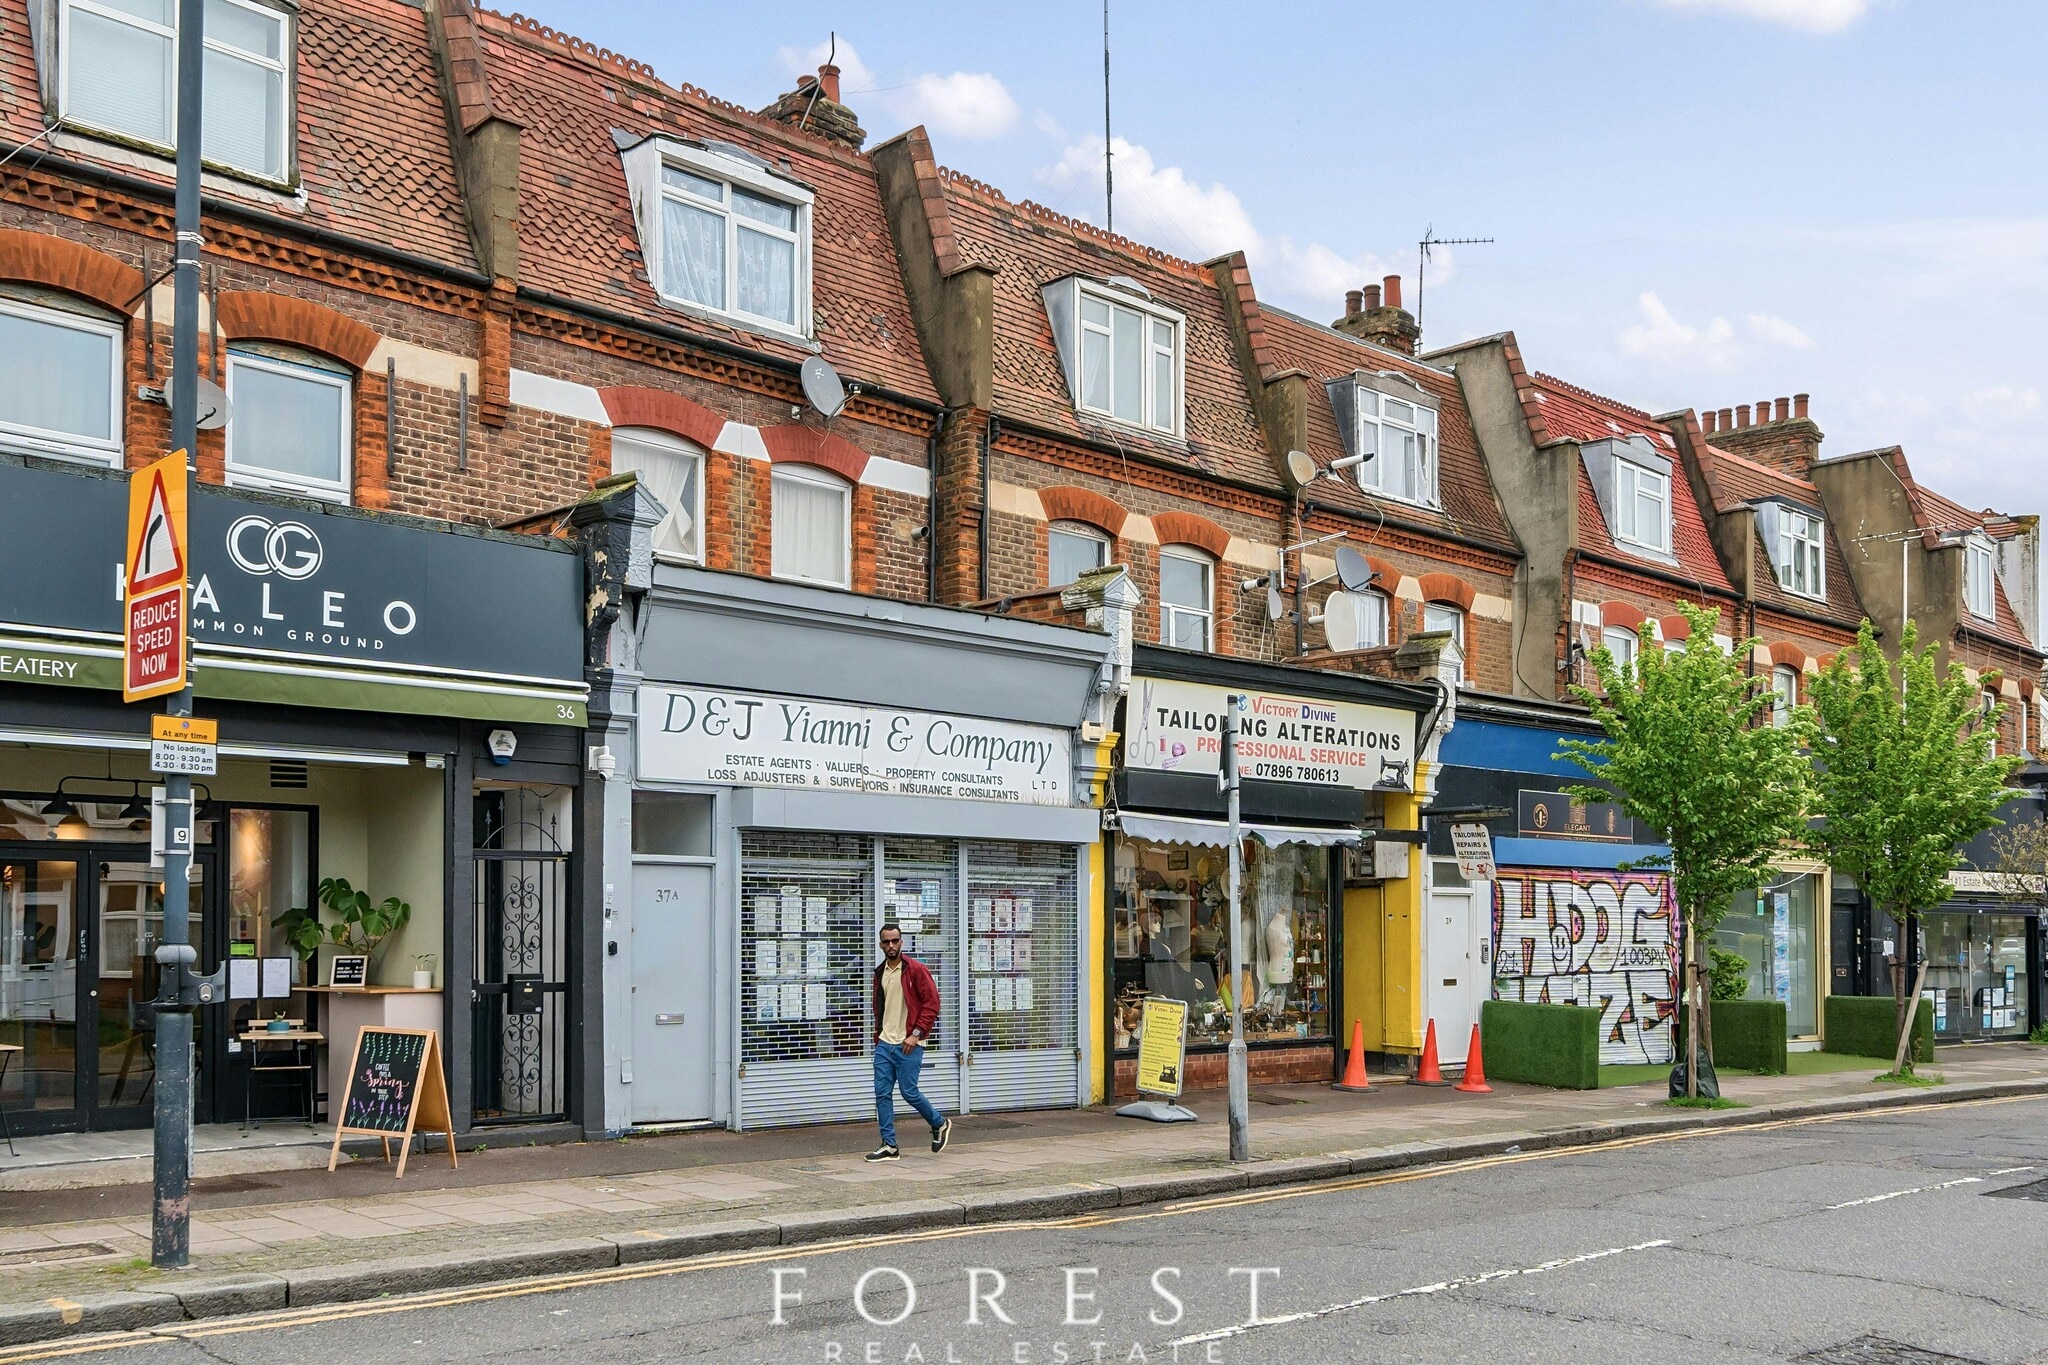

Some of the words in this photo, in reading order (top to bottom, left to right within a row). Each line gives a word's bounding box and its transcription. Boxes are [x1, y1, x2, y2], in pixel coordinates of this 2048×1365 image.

[133, 599, 177, 630] REDUCE
[137, 626, 172, 653] SPEED
[193, 618, 264, 636] MMON
[287, 630, 384, 650] GROUND
[0, 655, 78, 678] EATERY
[141, 652, 168, 676] NOW
[556, 704, 575, 719] 36
[1252, 697, 1299, 718] VICTORY
[1301, 704, 1336, 722] DIVINE
[162, 729, 172, 737] At
[174, 731, 188, 739] any
[191, 732, 208, 740] time
[778, 703, 871, 750] Yianni
[886, 716, 913, 752] &
[926, 720, 1053, 775] Company
[1157, 707, 1268, 738] TAILONG
[1277, 721, 1401, 751] ALTERATIONS
[163, 743, 175, 751] No
[177, 745, 206, 754] loading
[1196, 736, 1306, 762] PRESSIONAL
[1310, 747, 1366, 767] SERVICE
[725, 754, 765, 767] ESTATE
[770, 757, 812, 770] AGENTS
[825, 761, 870, 775] VALUERS
[885, 767, 936, 781] PROPERTY
[941, 771, 1003, 786] CONSULTANTS
[1255, 762, 1293, 779] 07896
[1297, 766, 1340, 783] 780613
[708, 768, 737, 780] LOSS
[743, 770, 806, 785] ADJUSTERS
[813, 775, 820, 785] &
[829, 776, 889, 792] SURVEYORS
[899, 783, 953, 796] INSURANCE
[958, 787, 1019, 800] CONSULTANTS
[178, 830, 187, 841] 9
[1564, 823, 1591, 832] ELEGANT
[655, 889, 679, 903] 37A
